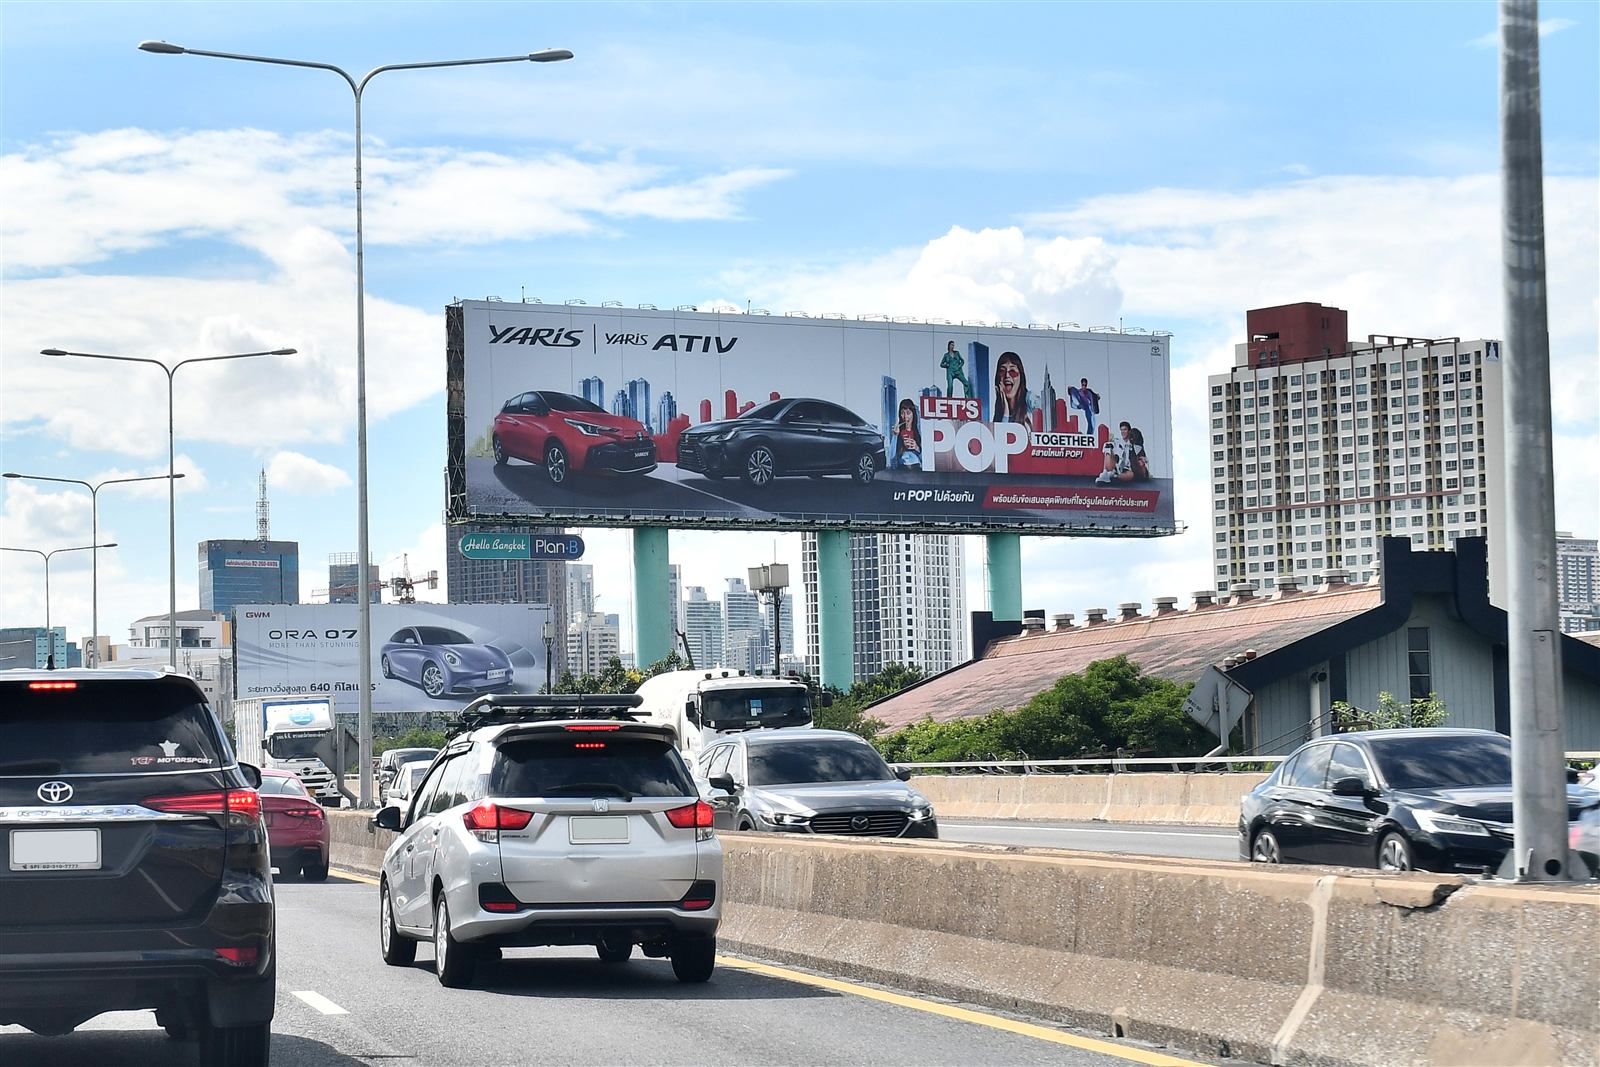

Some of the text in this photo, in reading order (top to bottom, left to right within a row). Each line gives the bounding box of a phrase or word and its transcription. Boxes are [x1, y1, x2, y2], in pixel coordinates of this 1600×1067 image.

[652, 334, 738, 353] ATIV
[923, 398, 979, 418] LET'S
[920, 419, 1029, 473] POP
[1035, 434, 1095, 447] TOGETHER
[894, 489, 975, 502] มา POP ไปด้วยกัน
[464, 538, 526, 552] Hello Bangkok
[245, 611, 271, 619] GWM
[268, 629, 358, 640] ORA 07
[310, 682, 331, 692] 640
[157, 756, 214, 765] MOTORSPORT
[0, 808, 137, 817] ORTUNER
